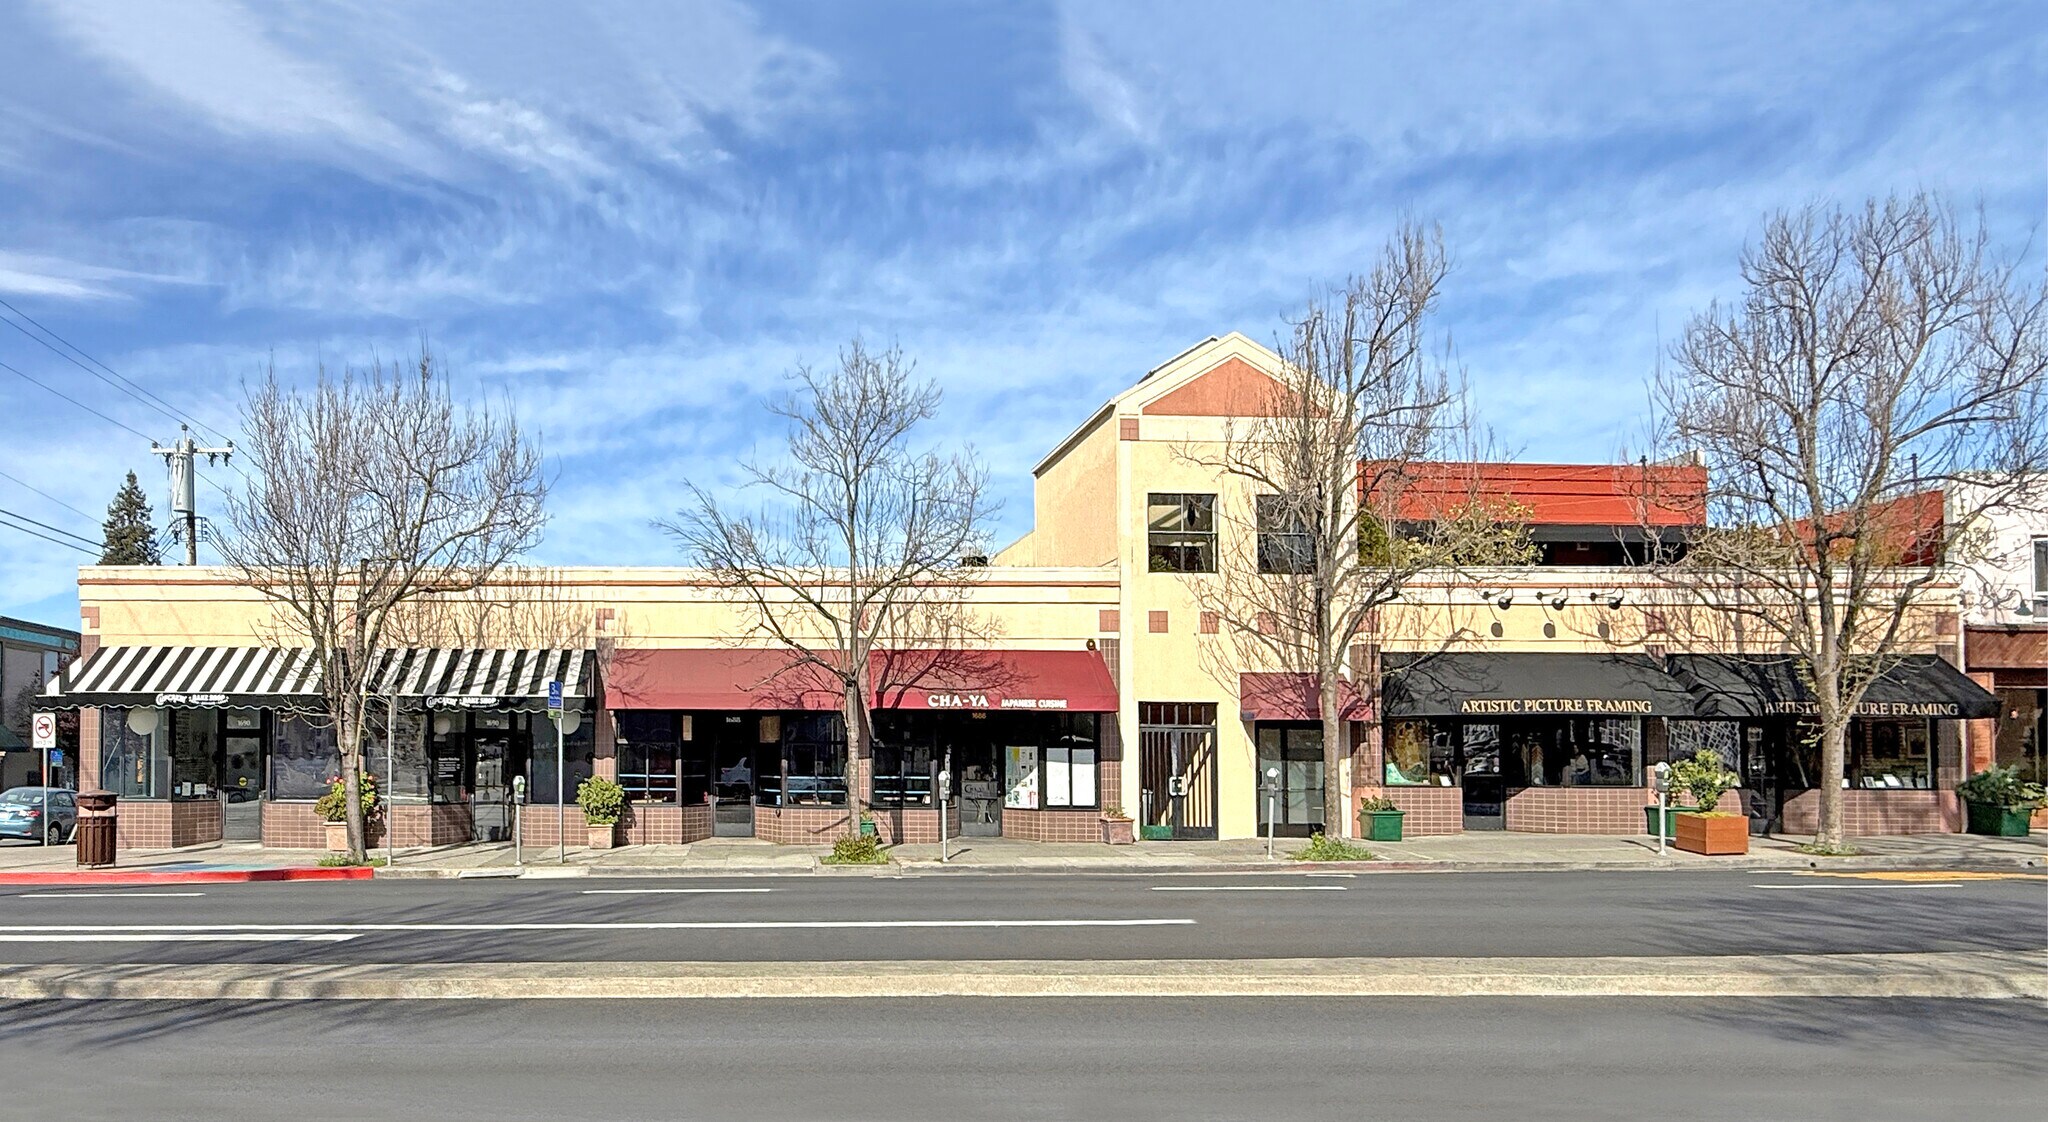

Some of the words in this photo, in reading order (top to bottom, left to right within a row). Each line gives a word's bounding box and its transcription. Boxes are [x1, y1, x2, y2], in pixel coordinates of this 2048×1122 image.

[928, 695, 989, 707] CHA-YA
[1001, 699, 1037, 708] JAPANESE
[1038, 699, 1067, 709] CUISINE
[1461, 700, 1520, 713] ARTISTIC
[1524, 700, 1583, 712] PICTURE
[1587, 700, 1652, 713] FRAMING
[1892, 703, 1959, 716] FRAMING
